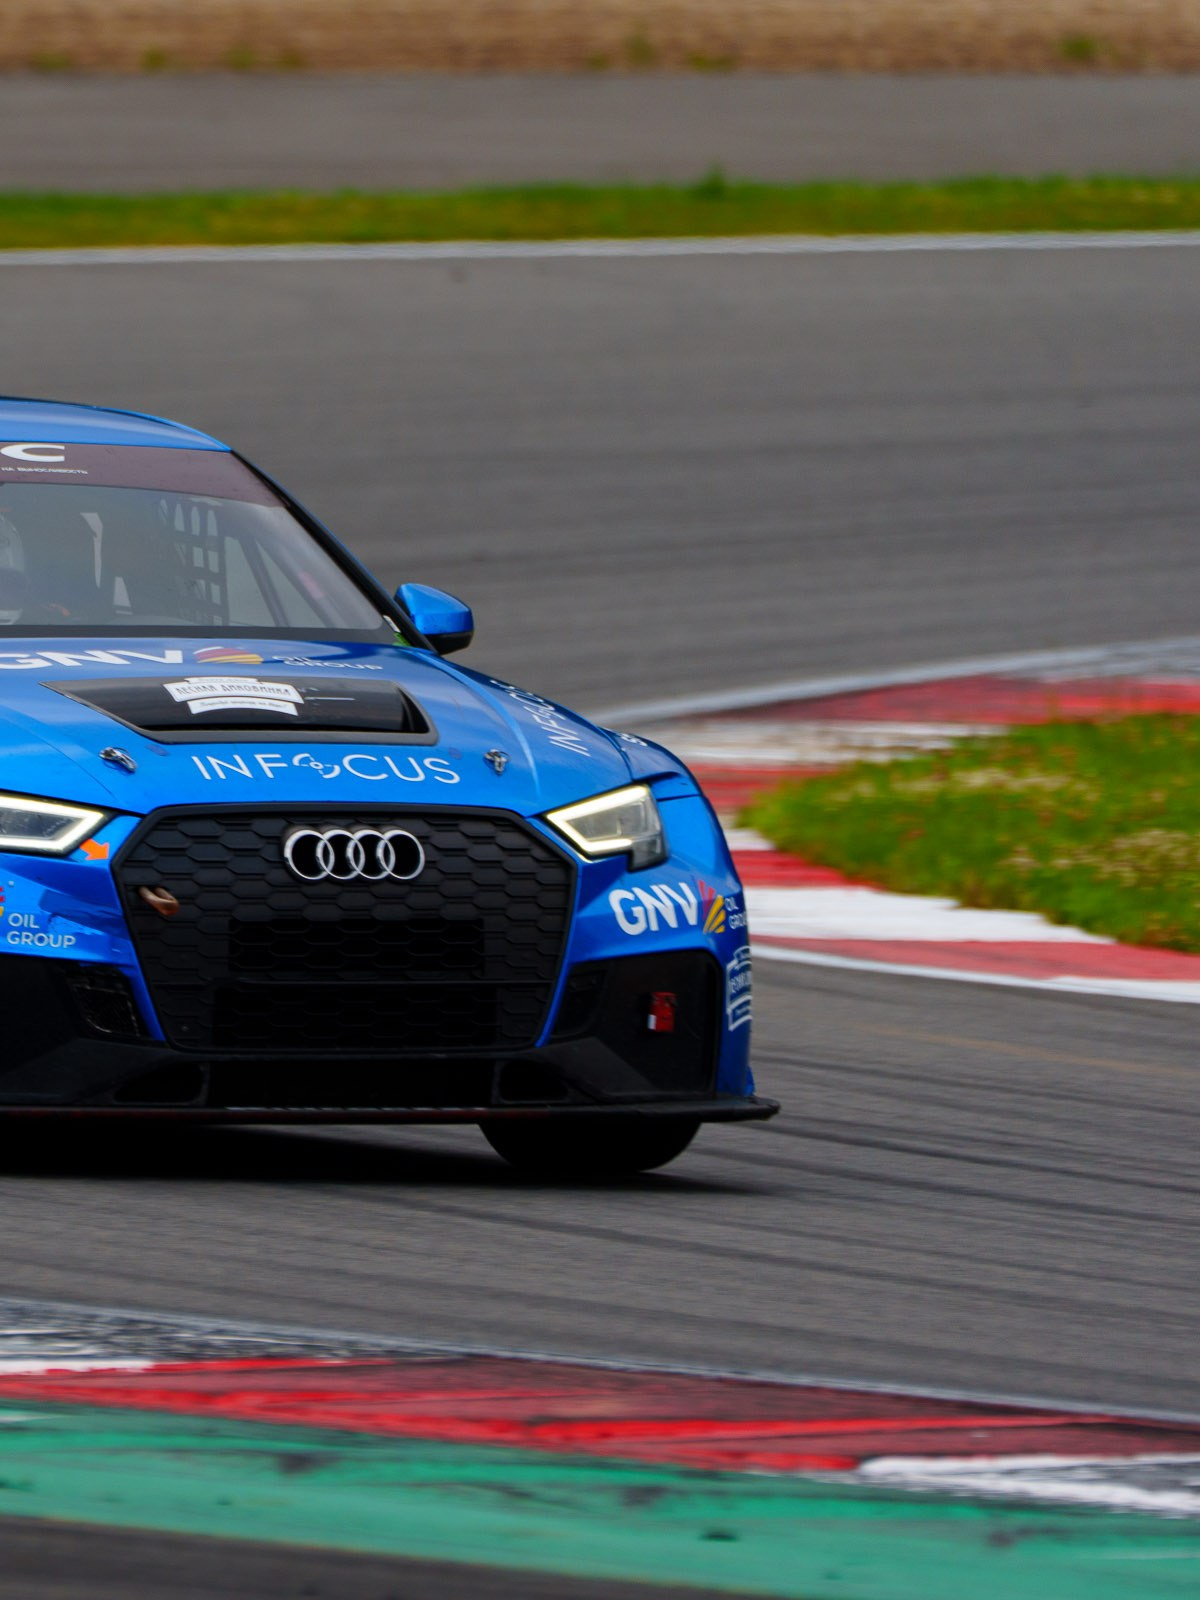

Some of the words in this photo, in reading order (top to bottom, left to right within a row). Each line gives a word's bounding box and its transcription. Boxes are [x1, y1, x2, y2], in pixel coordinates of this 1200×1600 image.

[608, 881, 699, 936] GNV
[8, 912, 40, 929] OIL
[6, 931, 77, 949] GROUP
